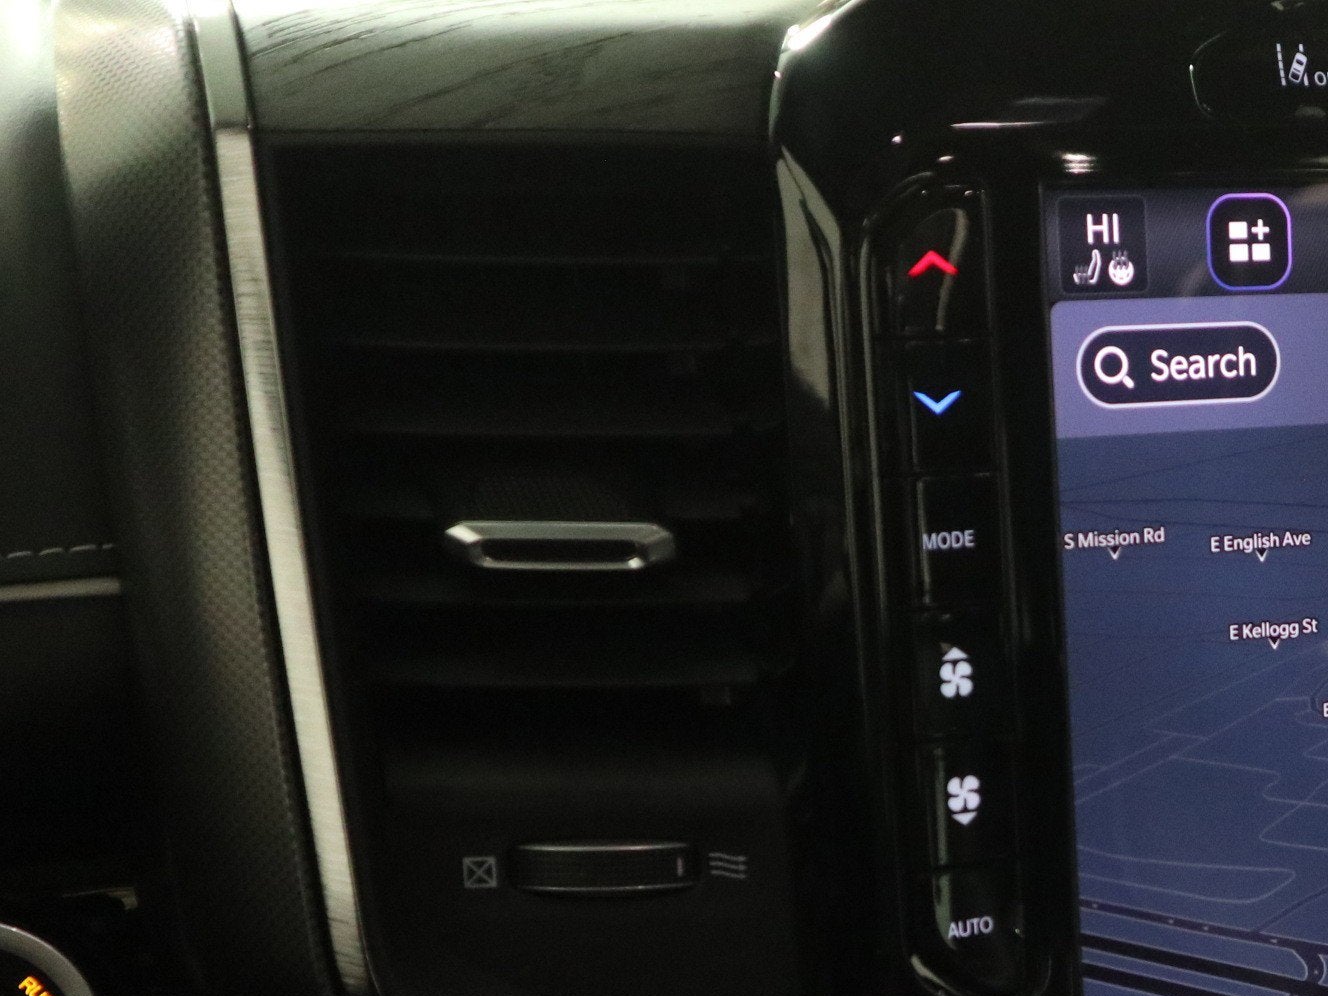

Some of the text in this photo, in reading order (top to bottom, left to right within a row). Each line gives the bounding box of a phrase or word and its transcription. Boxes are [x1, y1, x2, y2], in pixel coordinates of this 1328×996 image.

[1086, 213, 1120, 244] HI
[1150, 346, 1257, 382] Search
[922, 530, 976, 549] MODE
[1064, 527, 1165, 549] S Mission Rd
[1210, 531, 1311, 554] E English Ave
[1230, 618, 1318, 642] E Kellogg St
[948, 916, 994, 939] AUTO
